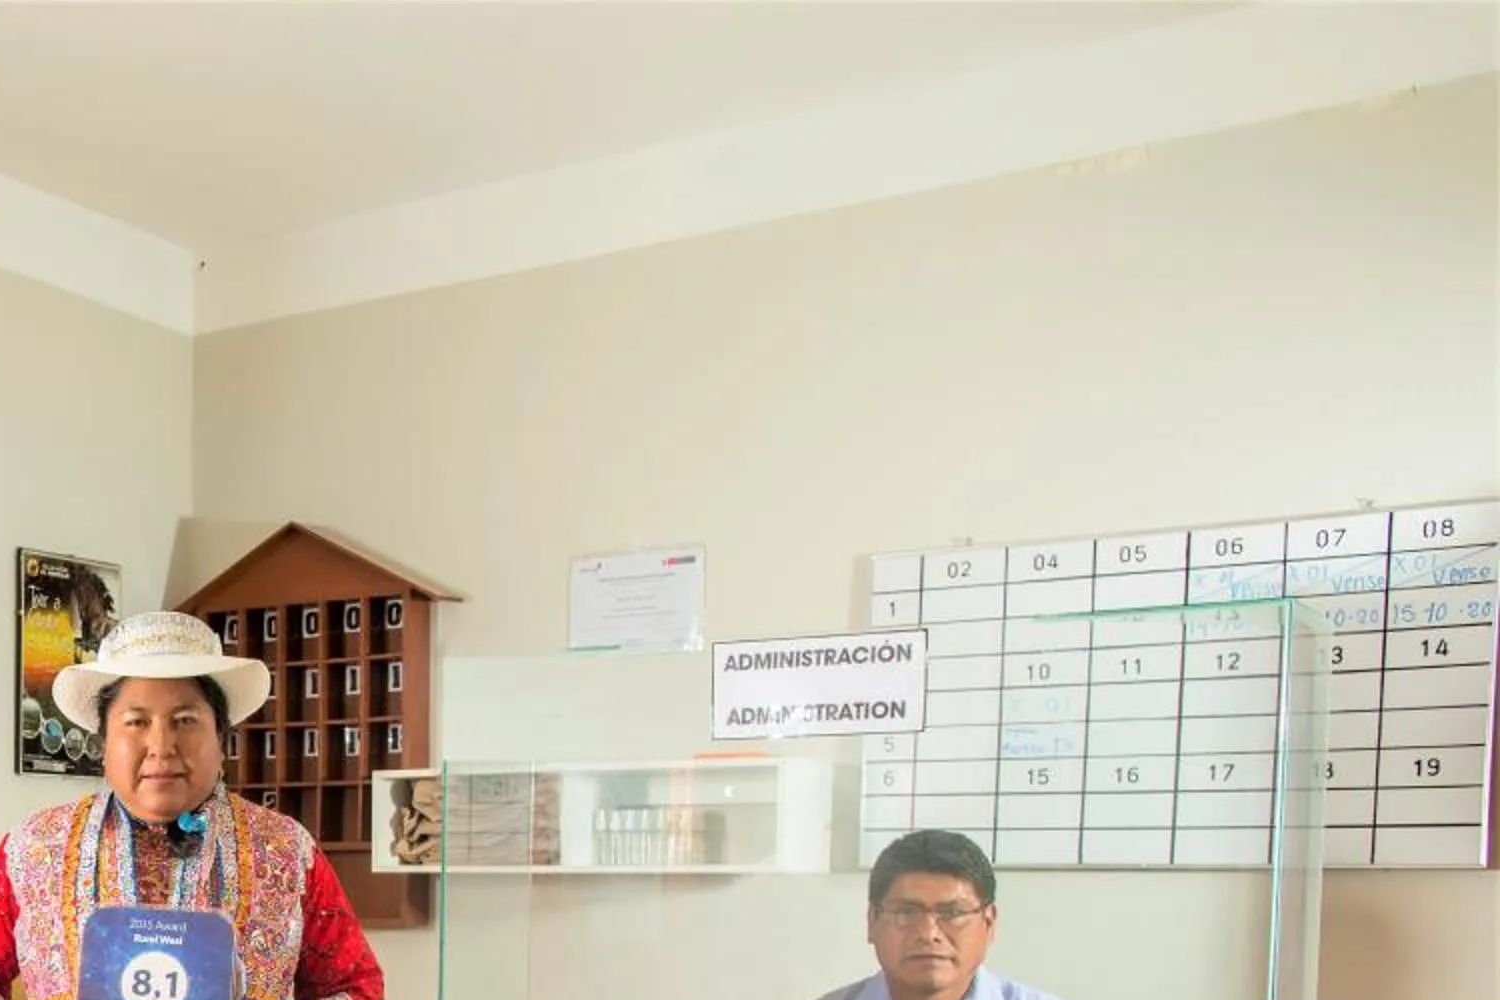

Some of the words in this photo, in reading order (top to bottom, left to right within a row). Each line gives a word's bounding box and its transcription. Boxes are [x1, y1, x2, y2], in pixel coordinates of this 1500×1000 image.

[947, 561, 972, 579] 02
[1033, 553, 1060, 571] 04
[1119, 546, 1148, 563] 05
[1215, 537, 1244, 557] 06
[1315, 528, 1348, 548] 07
[1422, 518, 1455, 538] 08
[723, 641, 913, 672] ADMINISTRACIÓN
[1026, 663, 1051, 681] 10
[1120, 658, 1143, 675] 11
[1215, 652, 1241, 671] 12
[1420, 638, 1449, 657] 14
[883, 736, 895, 753] 5
[883, 770, 895, 787] 6
[1027, 767, 1050, 785] 15
[1115, 766, 1140, 783] 16
[1209, 764, 1236, 782] 17
[1413, 758, 1442, 777] 19
[131, 969, 180, 999] 8,1
